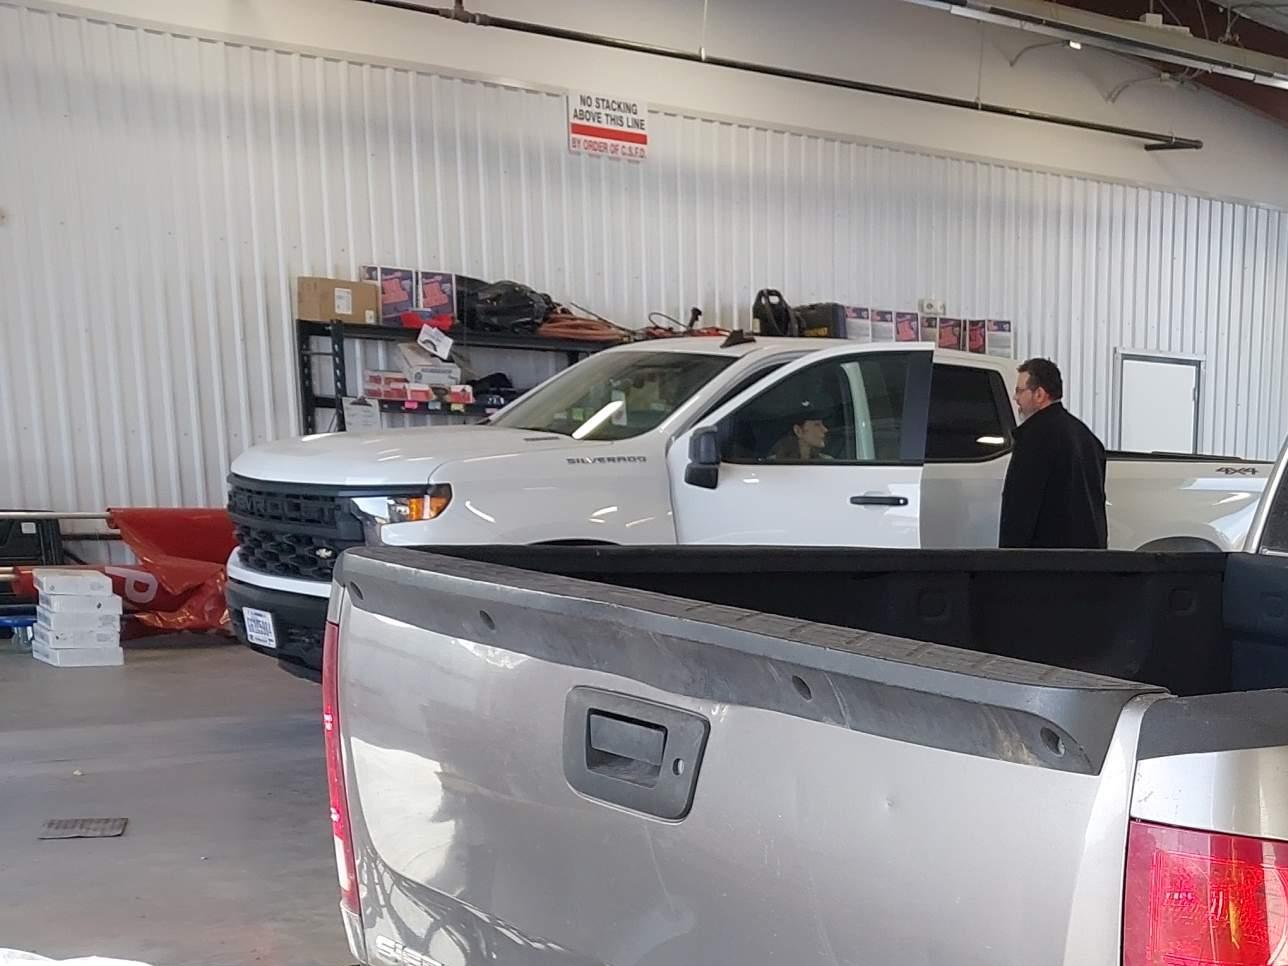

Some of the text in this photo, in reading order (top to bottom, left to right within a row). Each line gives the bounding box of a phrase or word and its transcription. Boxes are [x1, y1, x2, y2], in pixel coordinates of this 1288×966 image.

[579, 95, 638, 115] NO STACKING
[573, 109, 646, 131] ABOVE THIS LINE
[571, 137, 582, 149] BY
[582, 139, 608, 153] ORDER
[609, 143, 620, 156] OF
[565, 455, 647, 465] SILVERADO
